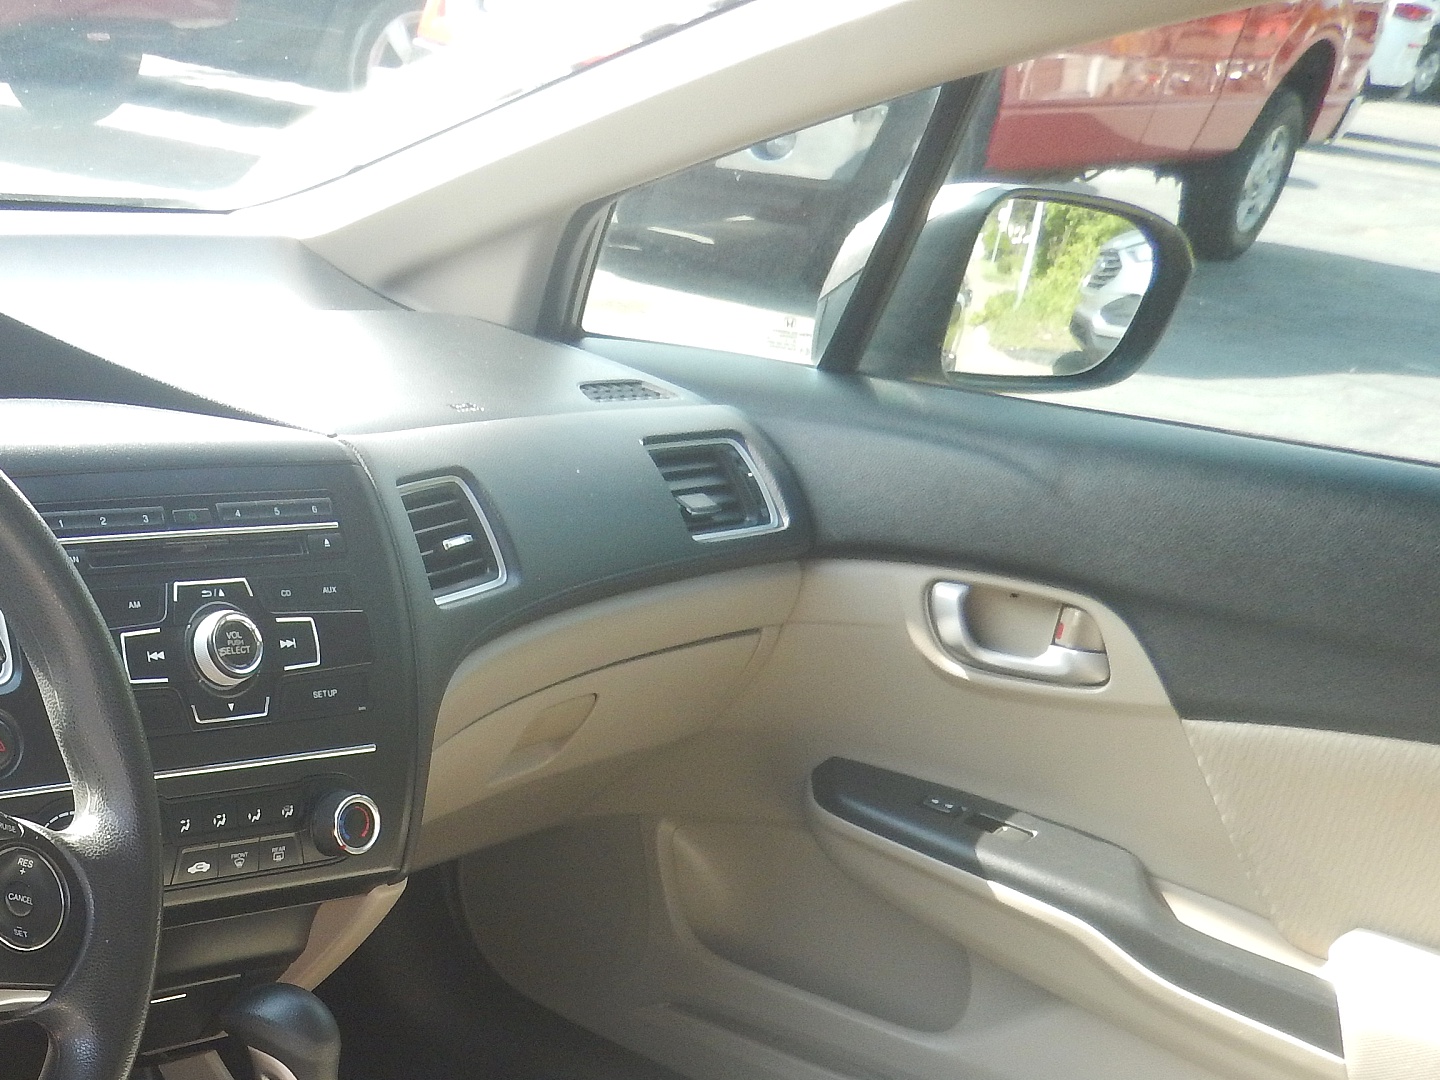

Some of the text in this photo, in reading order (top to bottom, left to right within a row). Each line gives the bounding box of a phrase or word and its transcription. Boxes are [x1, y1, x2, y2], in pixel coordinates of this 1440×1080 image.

[235, 508, 241, 517] 4
[274, 506, 281, 516] 5
[311, 505, 318, 514] 6
[99, 516, 107, 526] 2
[142, 514, 149, 523] 3
[58, 519, 64, 528] 1
[322, 586, 337, 594] AUX
[128, 600, 142, 609] AM
[226, 631, 242, 640] VOL
[221, 645, 250, 656] SELECT
[17, 857, 34, 869] RES
[8, 892, 33, 906] CANCEL
[13, 928, 28, 938] SET
